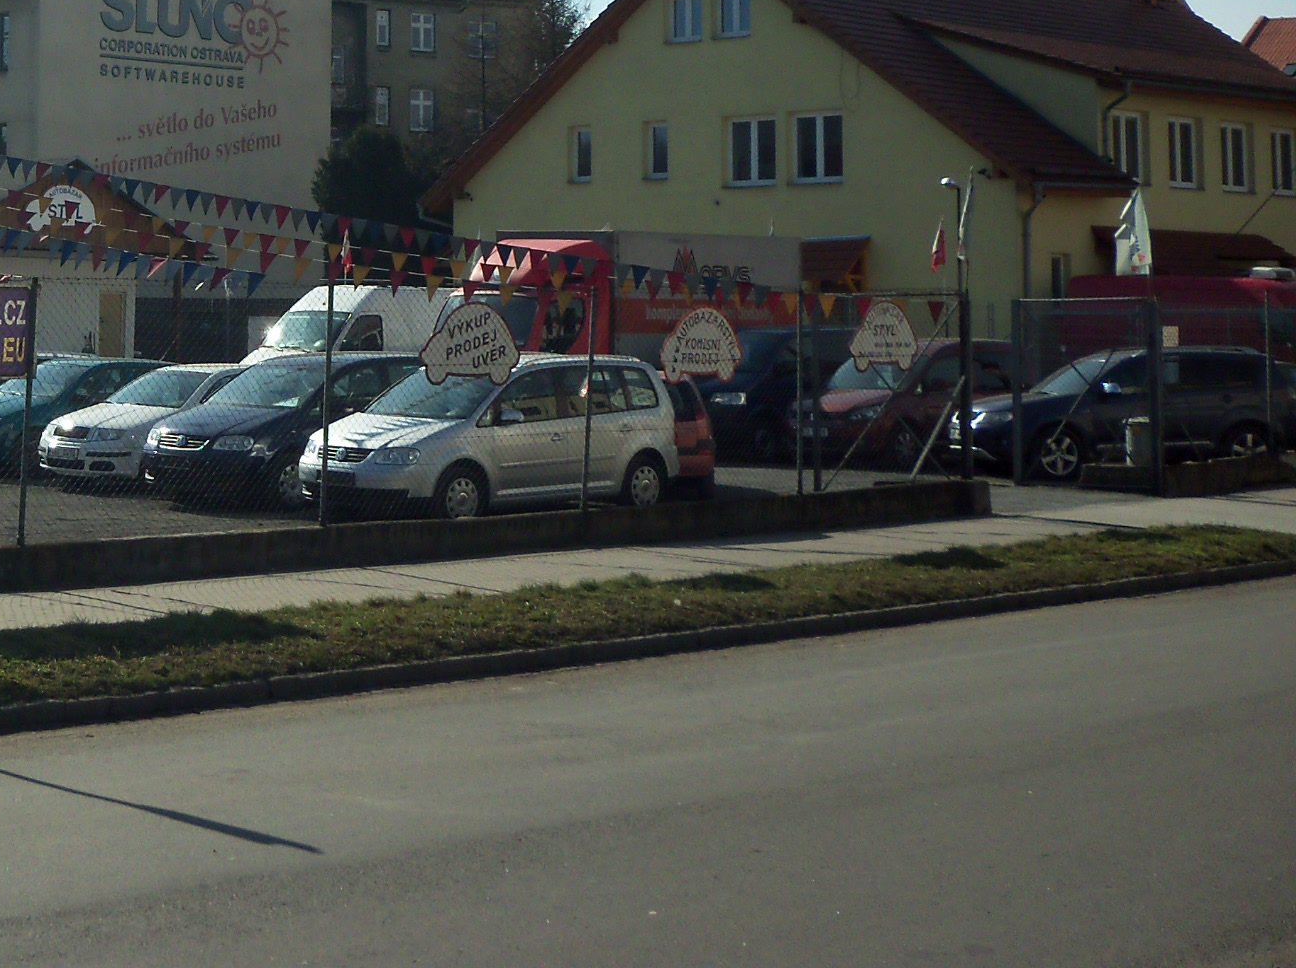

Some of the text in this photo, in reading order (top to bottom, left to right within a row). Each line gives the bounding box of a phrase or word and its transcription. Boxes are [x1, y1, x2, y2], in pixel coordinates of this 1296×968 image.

[99, 37, 244, 64] CORPORATION OSTRAVA
[99, 63, 245, 89] SOFTWAREHOUSE
[138, 112, 188, 139] světlo
[193, 108, 215, 130] do
[221, 99, 277, 125] Vašeho
[215, 131, 281, 162] systému
[49, 187, 83, 200] AUTOBAZAR
[48, 203, 83, 219] STL
[445, 329, 497, 361] PRODEJ
